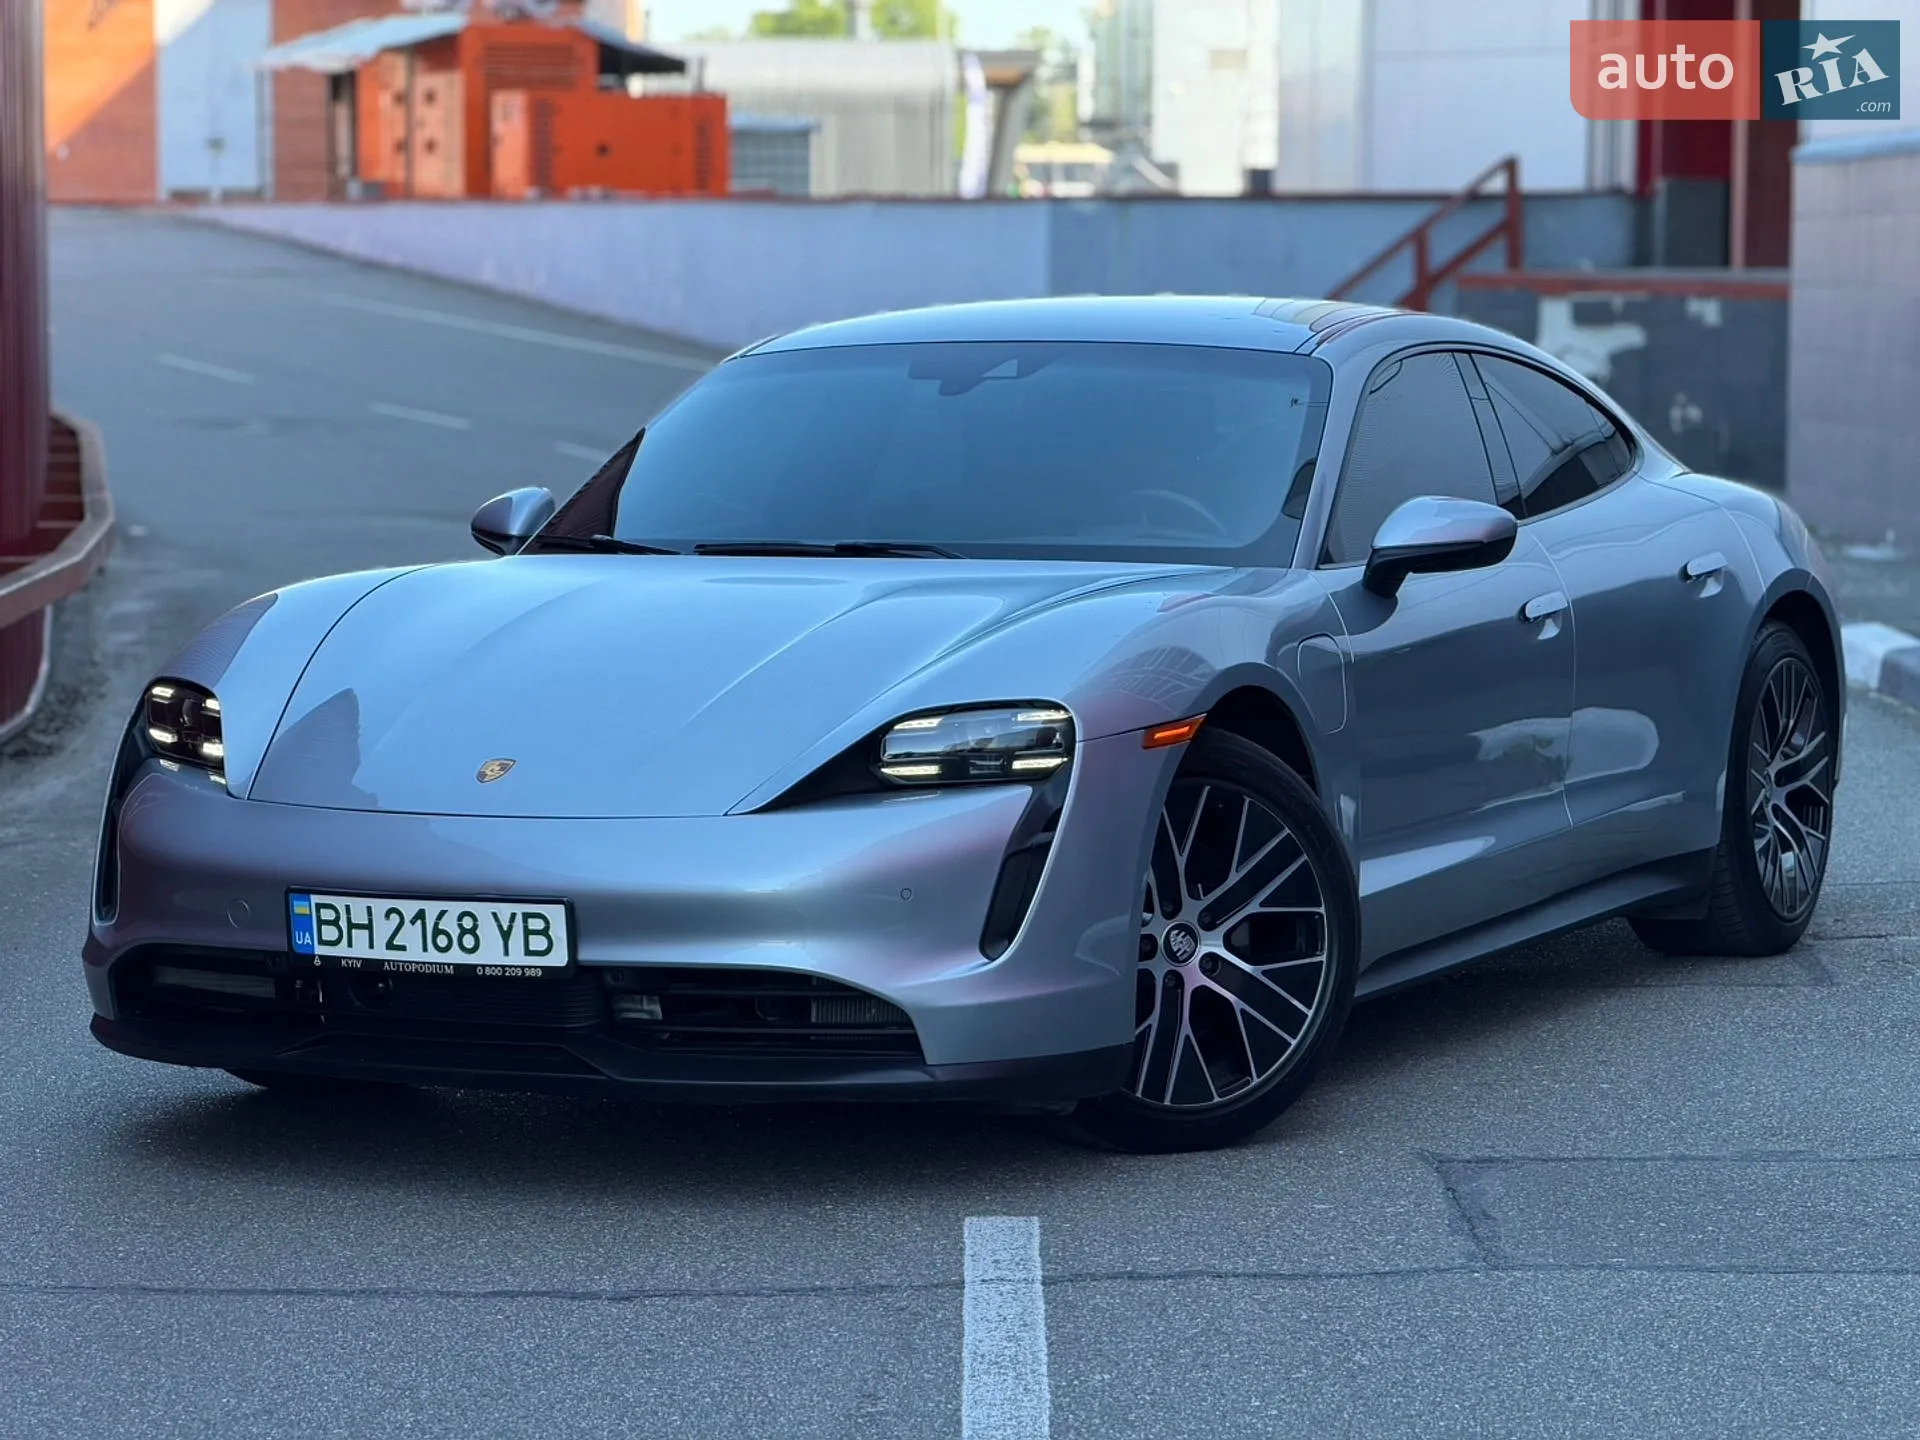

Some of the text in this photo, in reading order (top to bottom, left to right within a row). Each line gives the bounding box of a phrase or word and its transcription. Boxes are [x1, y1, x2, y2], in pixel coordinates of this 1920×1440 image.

[314, 902, 554, 957] BH 2168 YB
[295, 931, 312, 946] UA
[341, 958, 362, 968] KYIV
[383, 961, 454, 975] AUTOPODIUM
[484, 966, 502, 976] 800
[504, 967, 522, 976] 209
